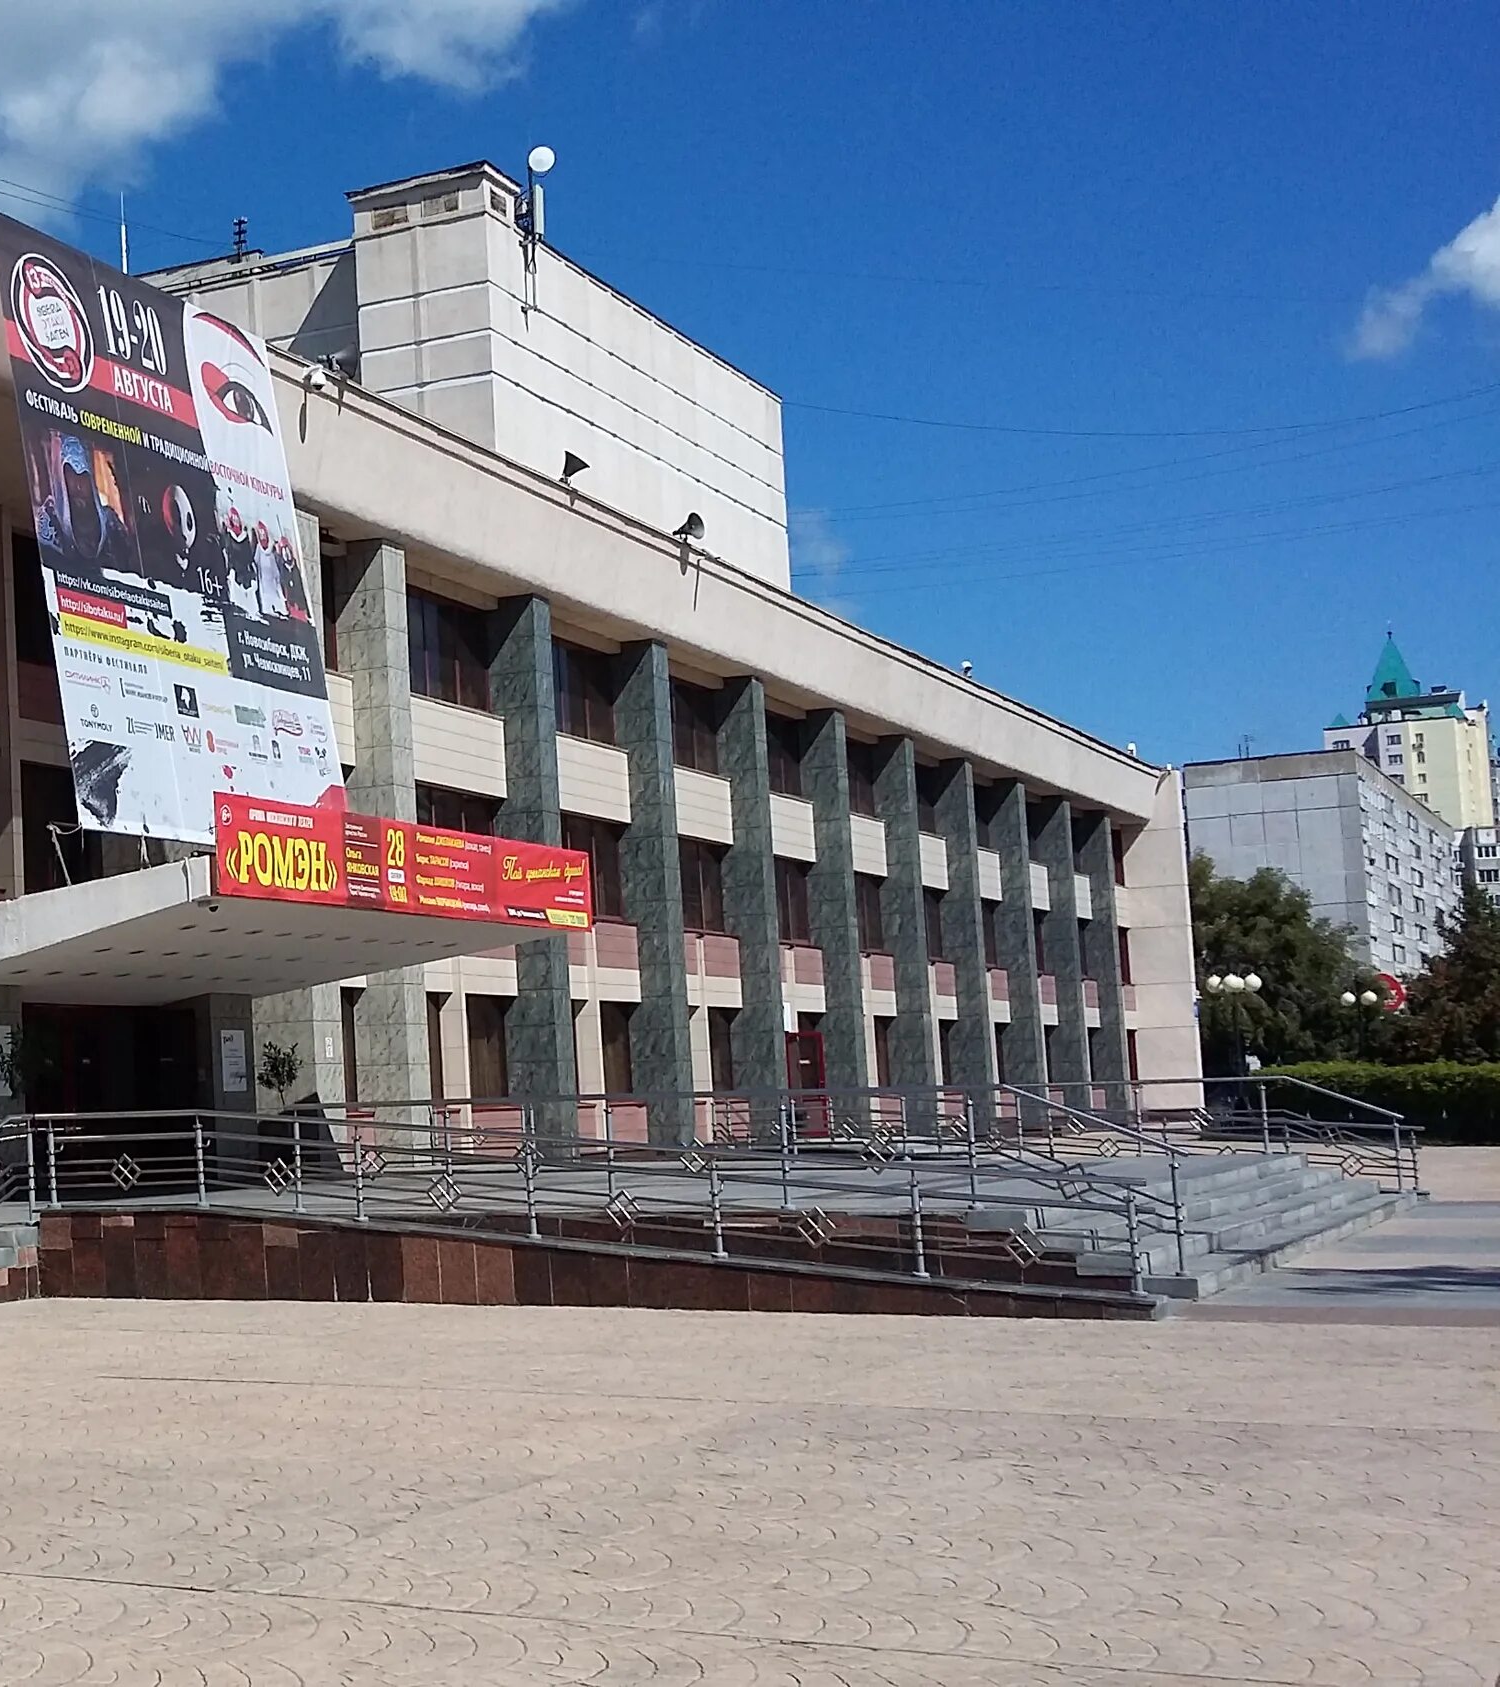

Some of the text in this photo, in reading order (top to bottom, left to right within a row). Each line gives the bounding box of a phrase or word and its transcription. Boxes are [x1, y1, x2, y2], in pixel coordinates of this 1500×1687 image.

[97, 285, 167, 375] 19-20
[113, 366, 173, 413] АВГУСТА
[26, 389, 79, 423] ФЕСТИВАЛЬ
[80, 410, 142, 446] СОВРЕМЕННОЙ
[142, 432, 150, 449] И
[150, 434, 210, 473] ТРАДИЦИОННОЙ
[210, 460, 250, 488] ВОСТОЧНОЙ
[197, 566, 223, 597] 16+
[302, 666, 312, 682] 11
[80, 718, 113, 733] TONYMOLY
[226, 830, 338, 892] «РОМЭН»
[387, 829, 405, 867] 28
